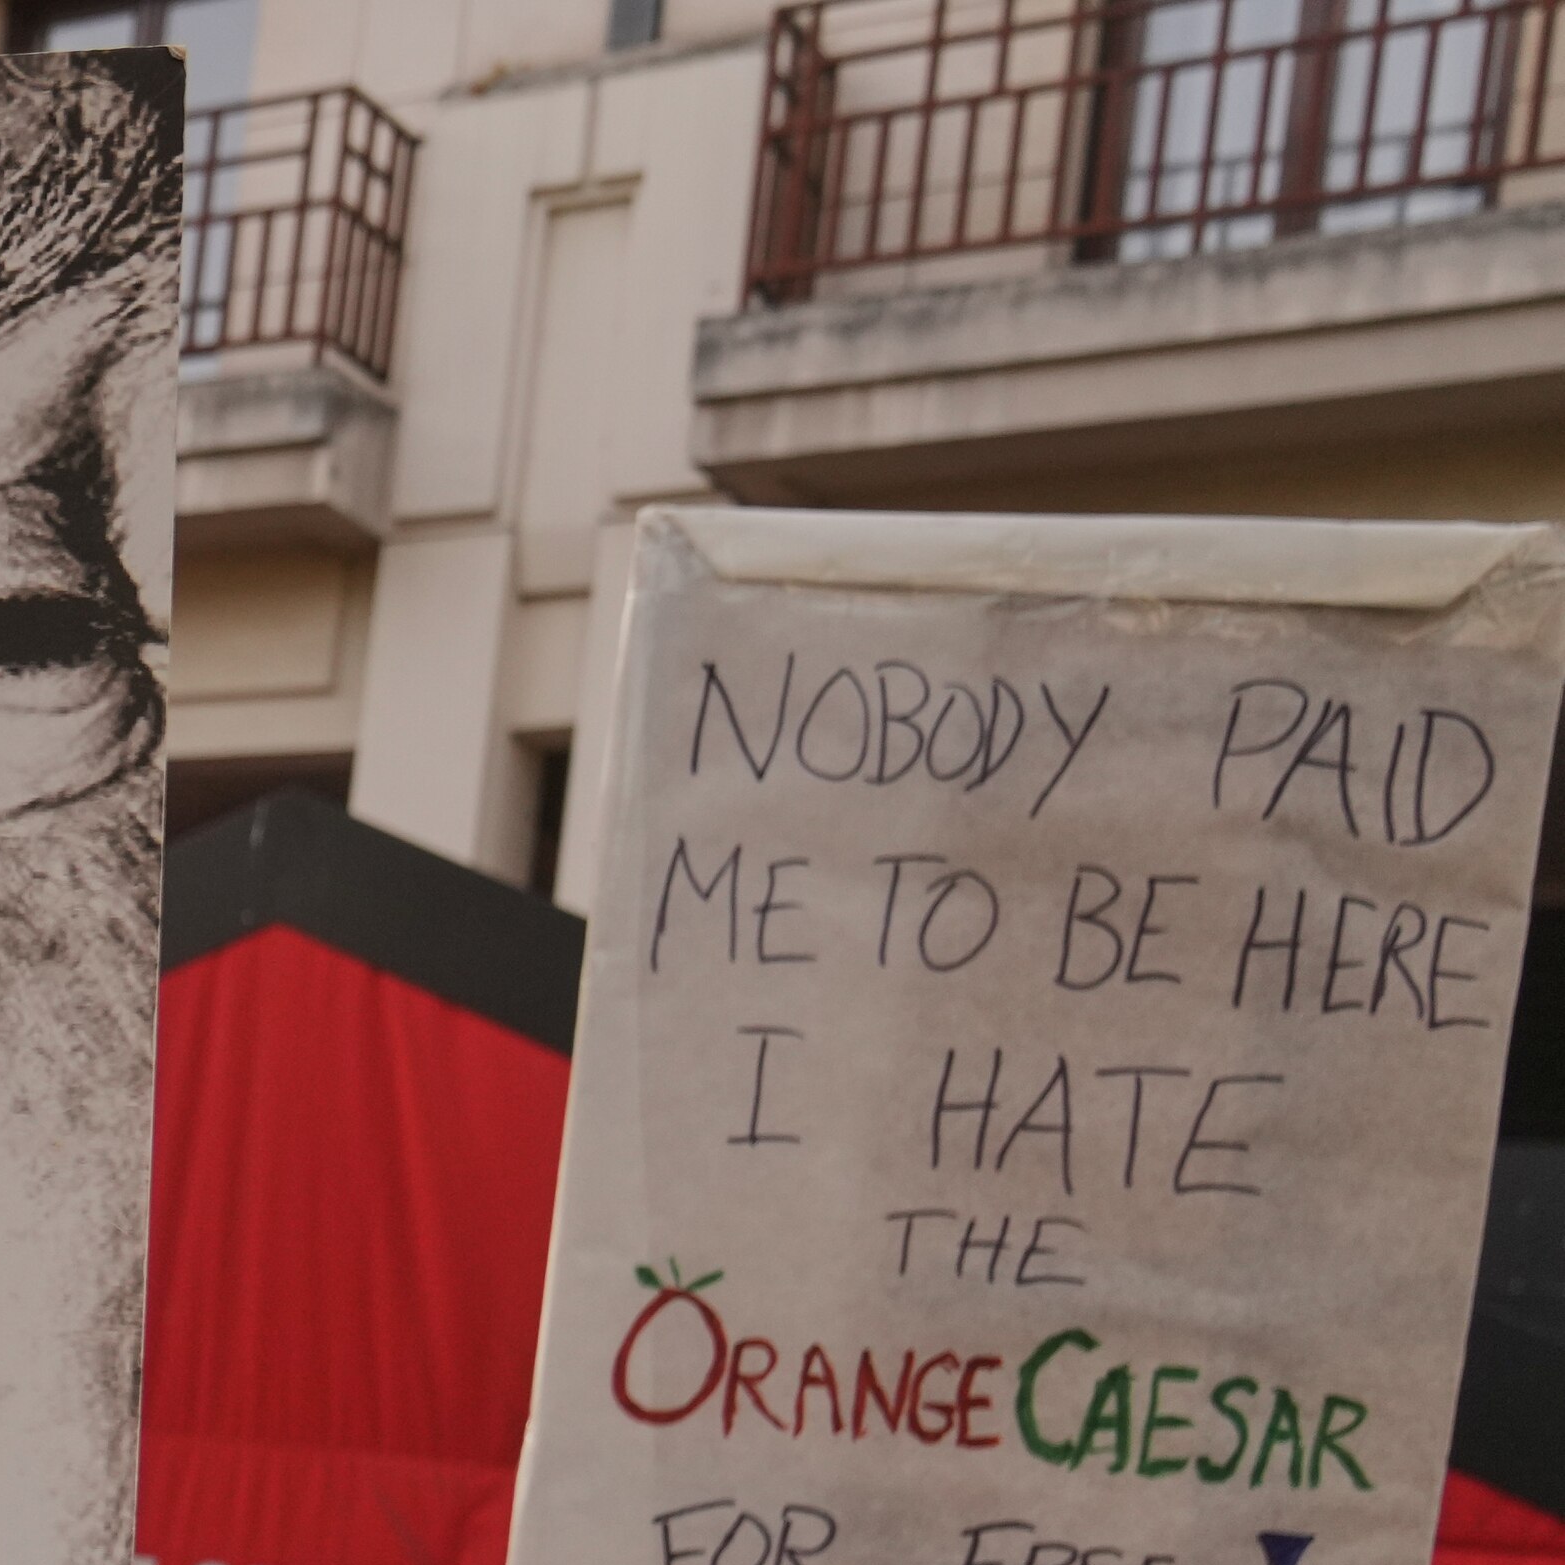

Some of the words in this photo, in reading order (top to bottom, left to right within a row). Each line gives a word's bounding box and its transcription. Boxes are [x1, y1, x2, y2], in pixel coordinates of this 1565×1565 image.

[689, 654, 1111, 818] NOBODY
[1214, 679, 1498, 847] PAID
[651, 837, 819, 975] ME
[874, 854, 1001, 972] TO
[1054, 865, 1201, 991] BE
[1232, 887, 1493, 1030] HERE
[727, 1027, 805, 1147] I
[929, 1047, 1285, 1197] HATE
[886, 1208, 1088, 1286] THE
